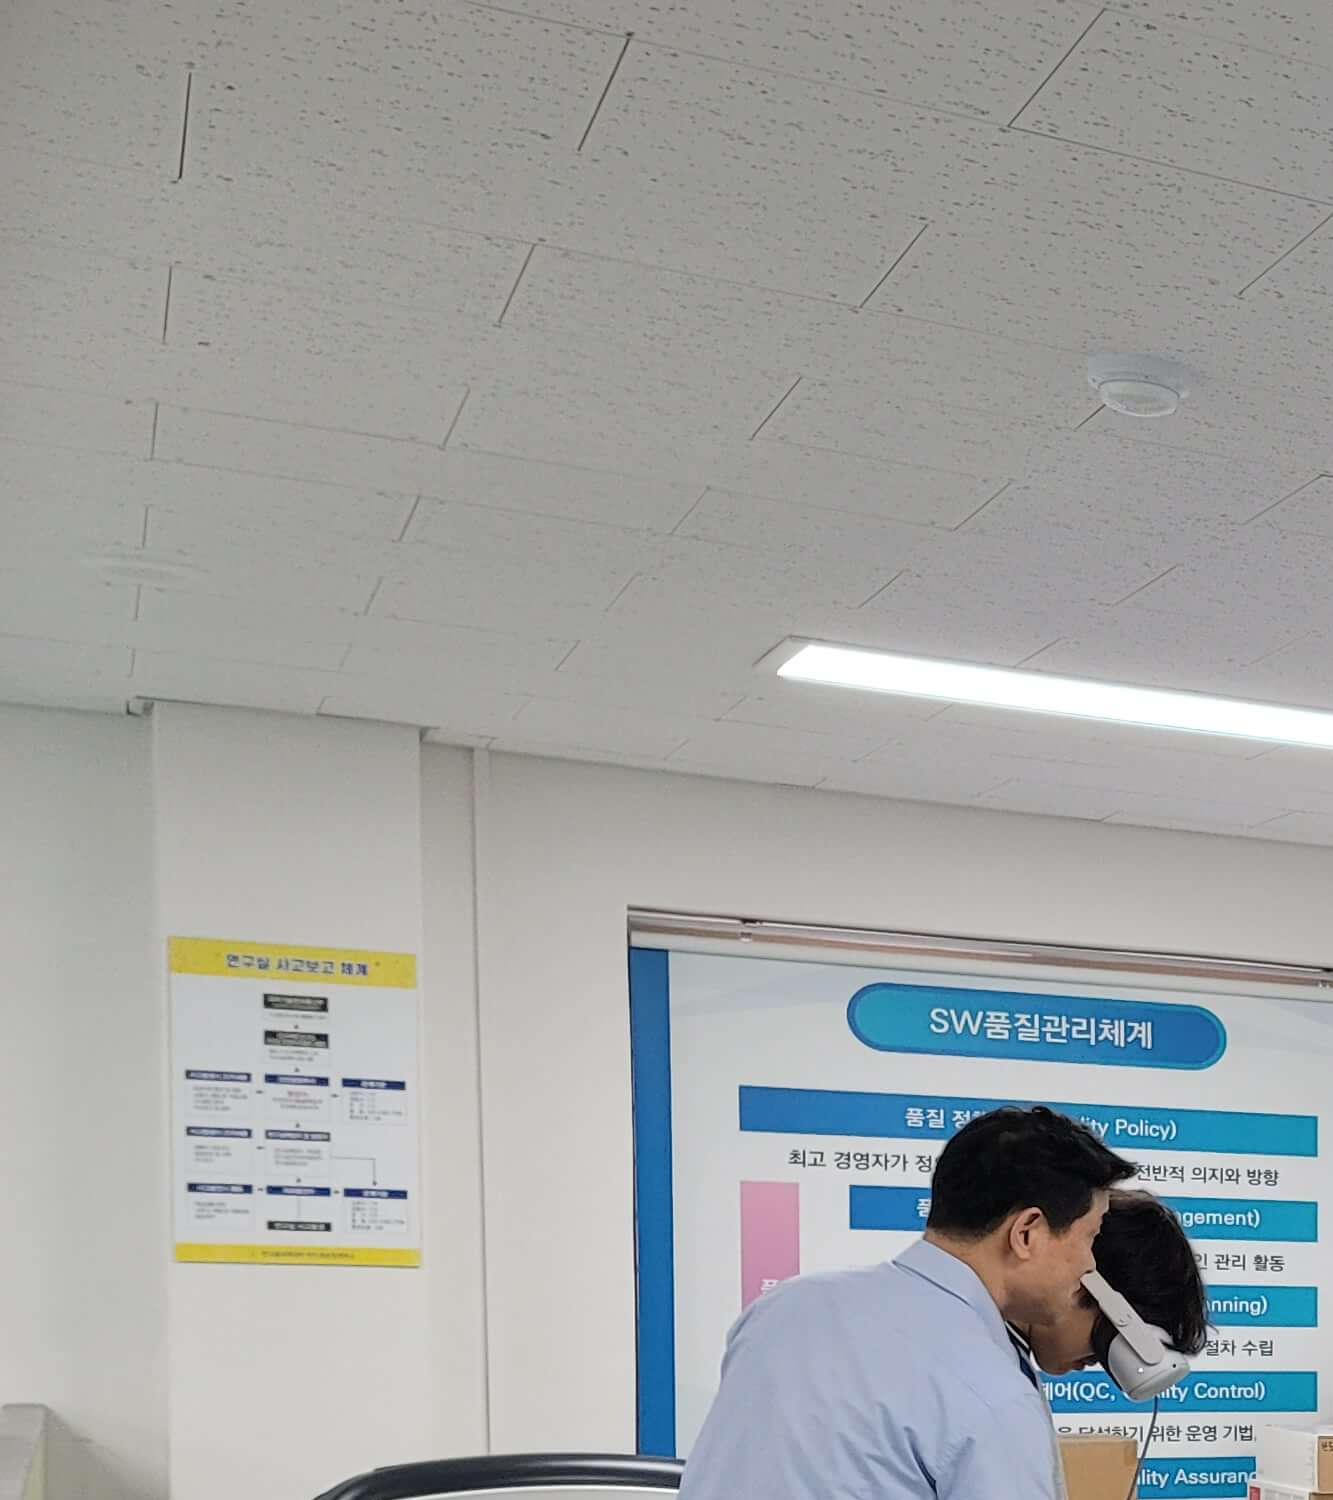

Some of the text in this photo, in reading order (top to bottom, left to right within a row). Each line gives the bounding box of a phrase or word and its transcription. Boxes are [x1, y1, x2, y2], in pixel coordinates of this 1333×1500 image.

[929, 1007, 1152, 1049] SW품질관리체계
[904, 1107, 945, 1129] 품질
[1115, 1118, 1177, 1141] Policy)
[788, 1149, 827, 1168] 최고
[833, 1151, 909, 1172] 경영자가
[1135, 1163, 1185, 1183] 전반적
[1191, 1166, 1242, 1185] 의지와
[1247, 1169, 1279, 1187] 방향
[1177, 1208, 1261, 1229] gement)
[1214, 1254, 1246, 1271] 관리
[1253, 1254, 1286, 1272] 활동
[1206, 1295, 1268, 1317] nning)
[1205, 1339, 1273, 1357] 절차 수립
[1194, 1382, 1266, 1401] Control)
[1151, 1425, 1182, 1442] 위한
[1186, 1425, 1217, 1442] 운영
